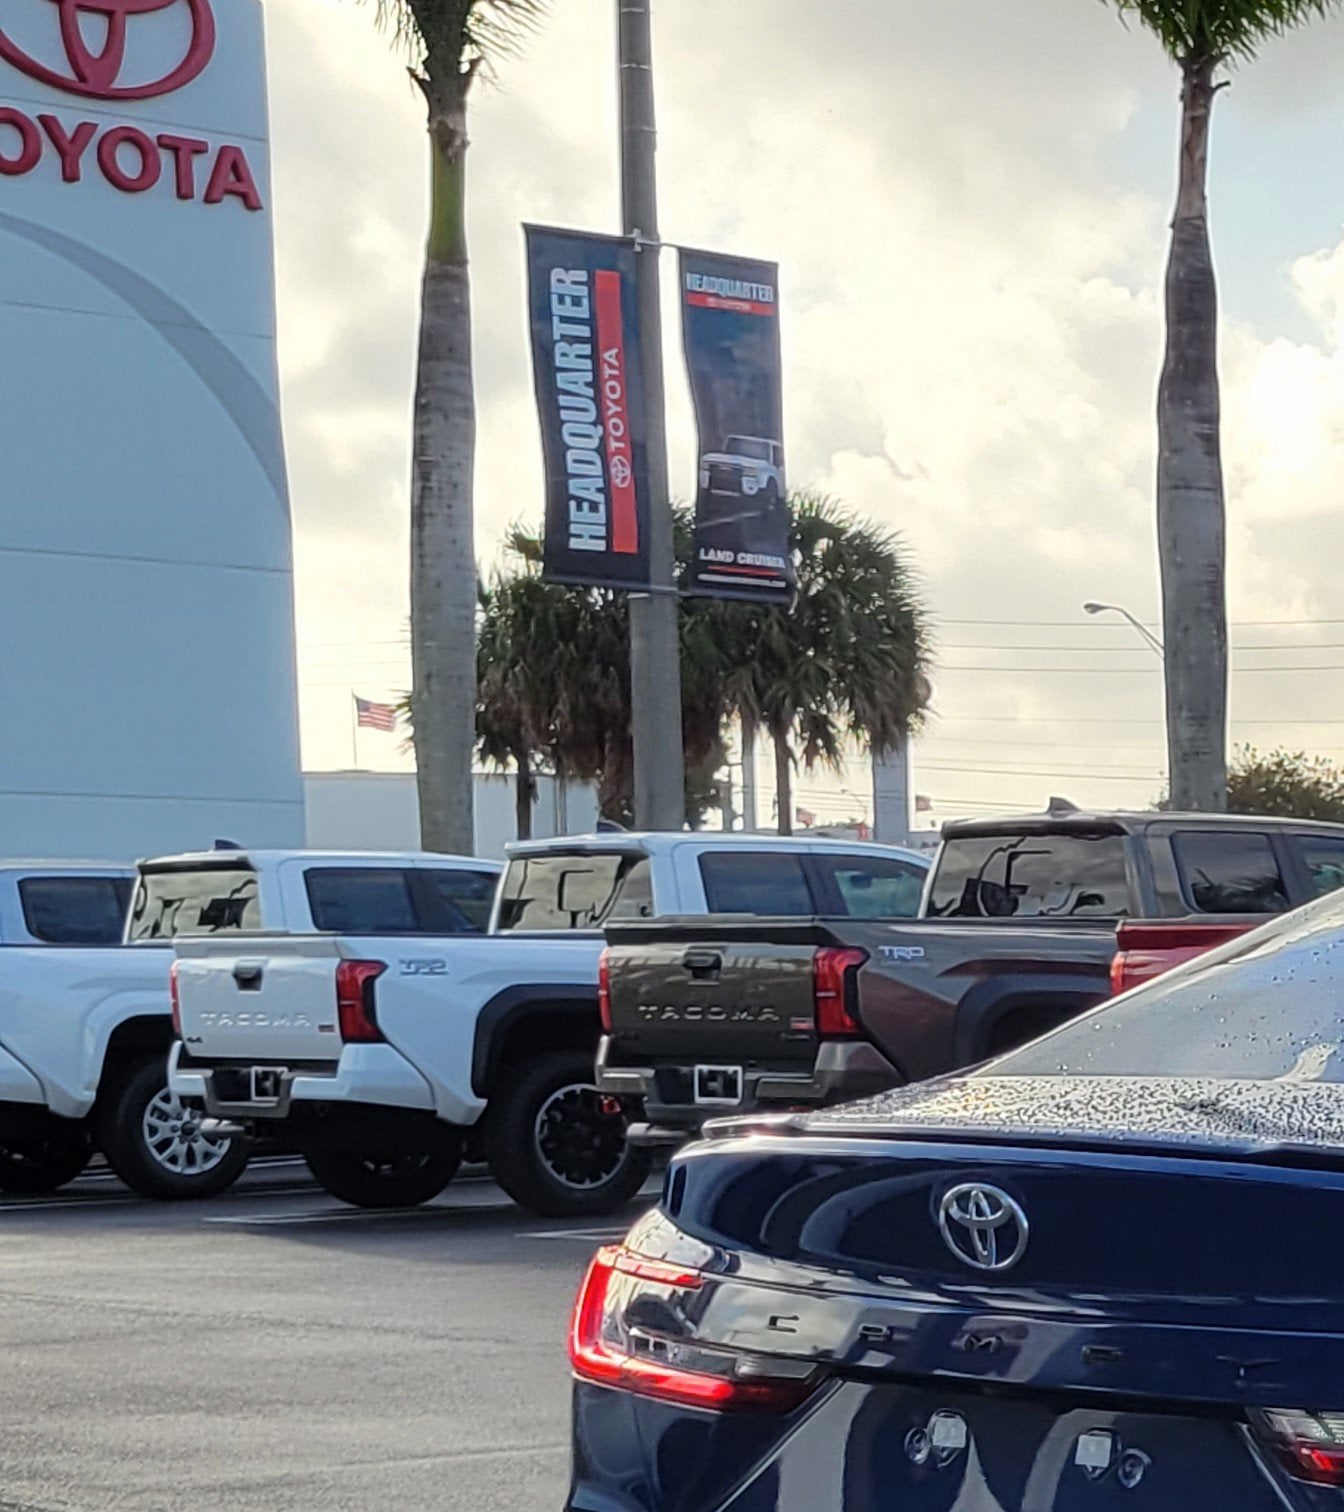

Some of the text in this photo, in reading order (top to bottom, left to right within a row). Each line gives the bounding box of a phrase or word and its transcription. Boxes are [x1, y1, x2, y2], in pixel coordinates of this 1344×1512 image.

[600, 347, 625, 451] TOYOTA
[548, 267, 607, 552] HEADQUARTER
[699, 547, 734, 563] LAND
[878, 944, 925, 960] TRD
[200, 1012, 311, 1027] TACOMA
[637, 1005, 780, 1021] TACOMA
